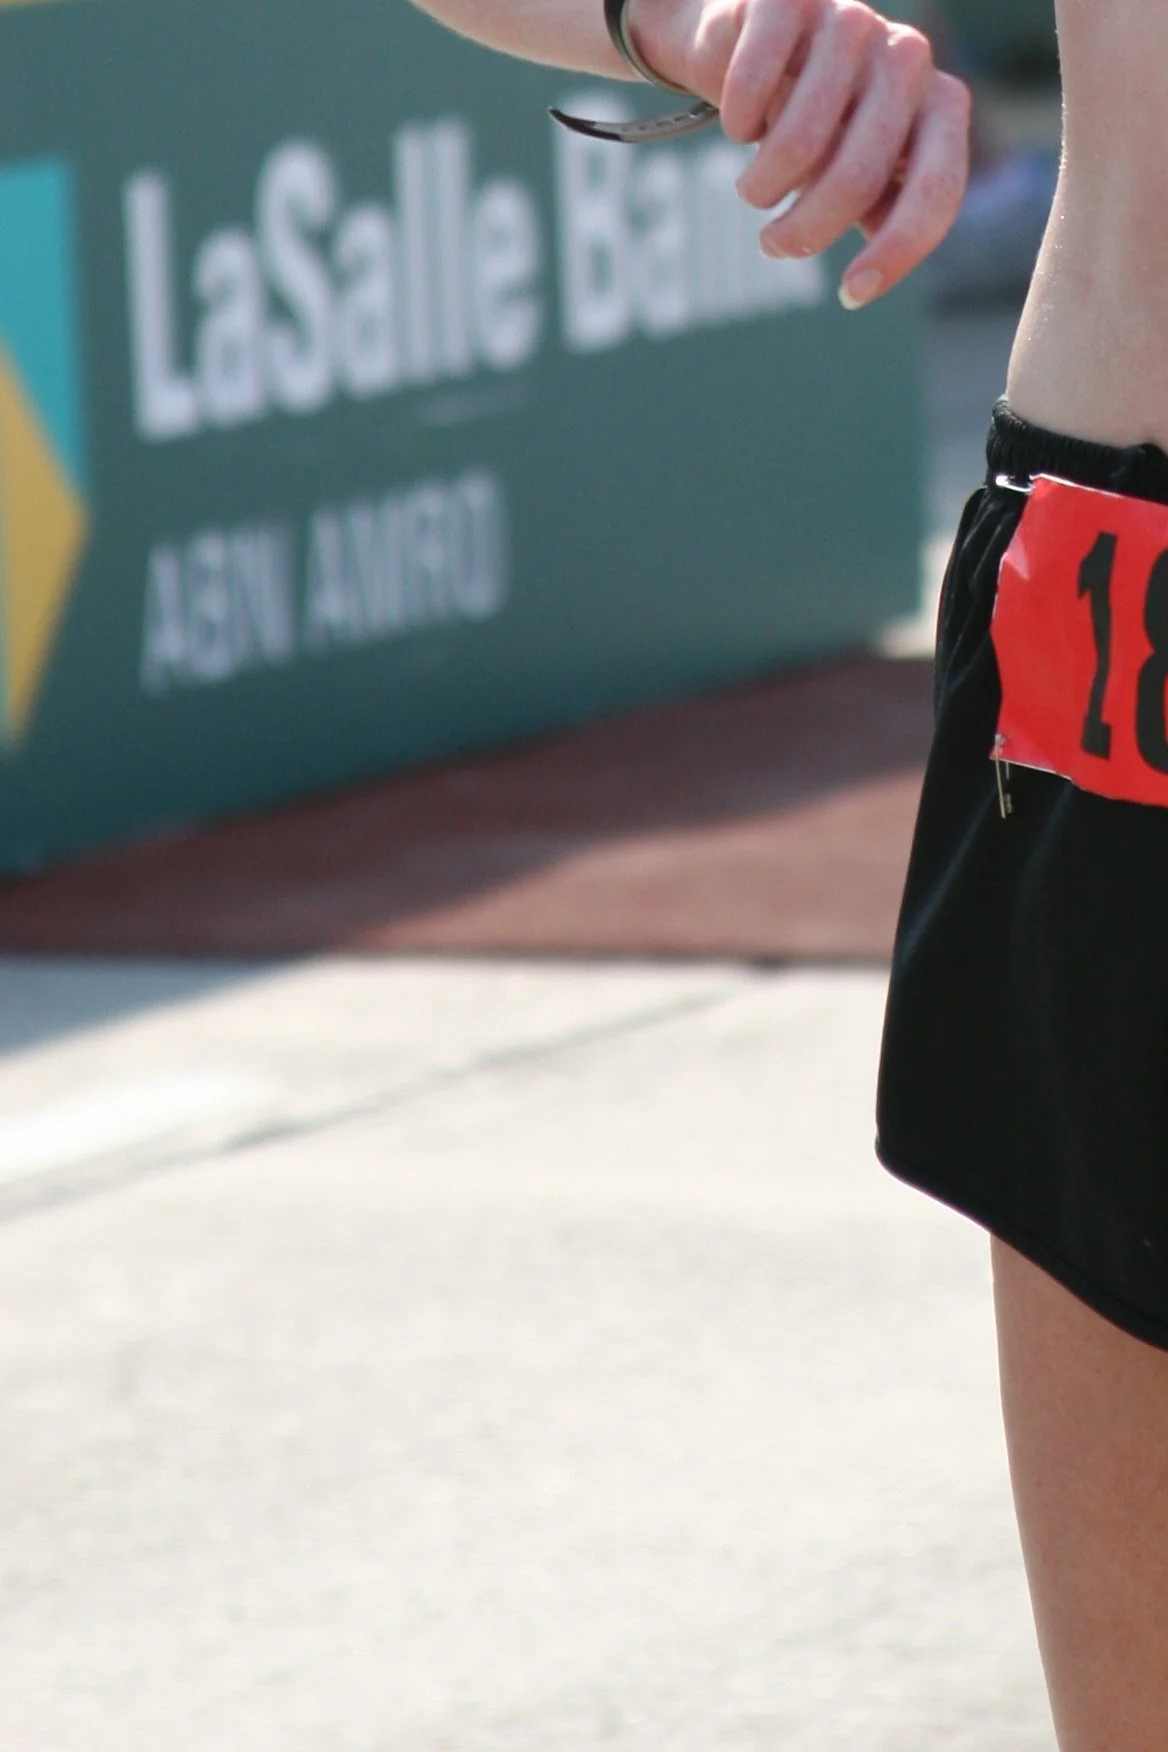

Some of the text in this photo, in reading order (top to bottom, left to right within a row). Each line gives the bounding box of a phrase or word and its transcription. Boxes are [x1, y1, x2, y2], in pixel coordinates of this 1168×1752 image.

[122, 114, 546, 444] LaSalle
[139, 462, 510, 694] ABN AMRO
